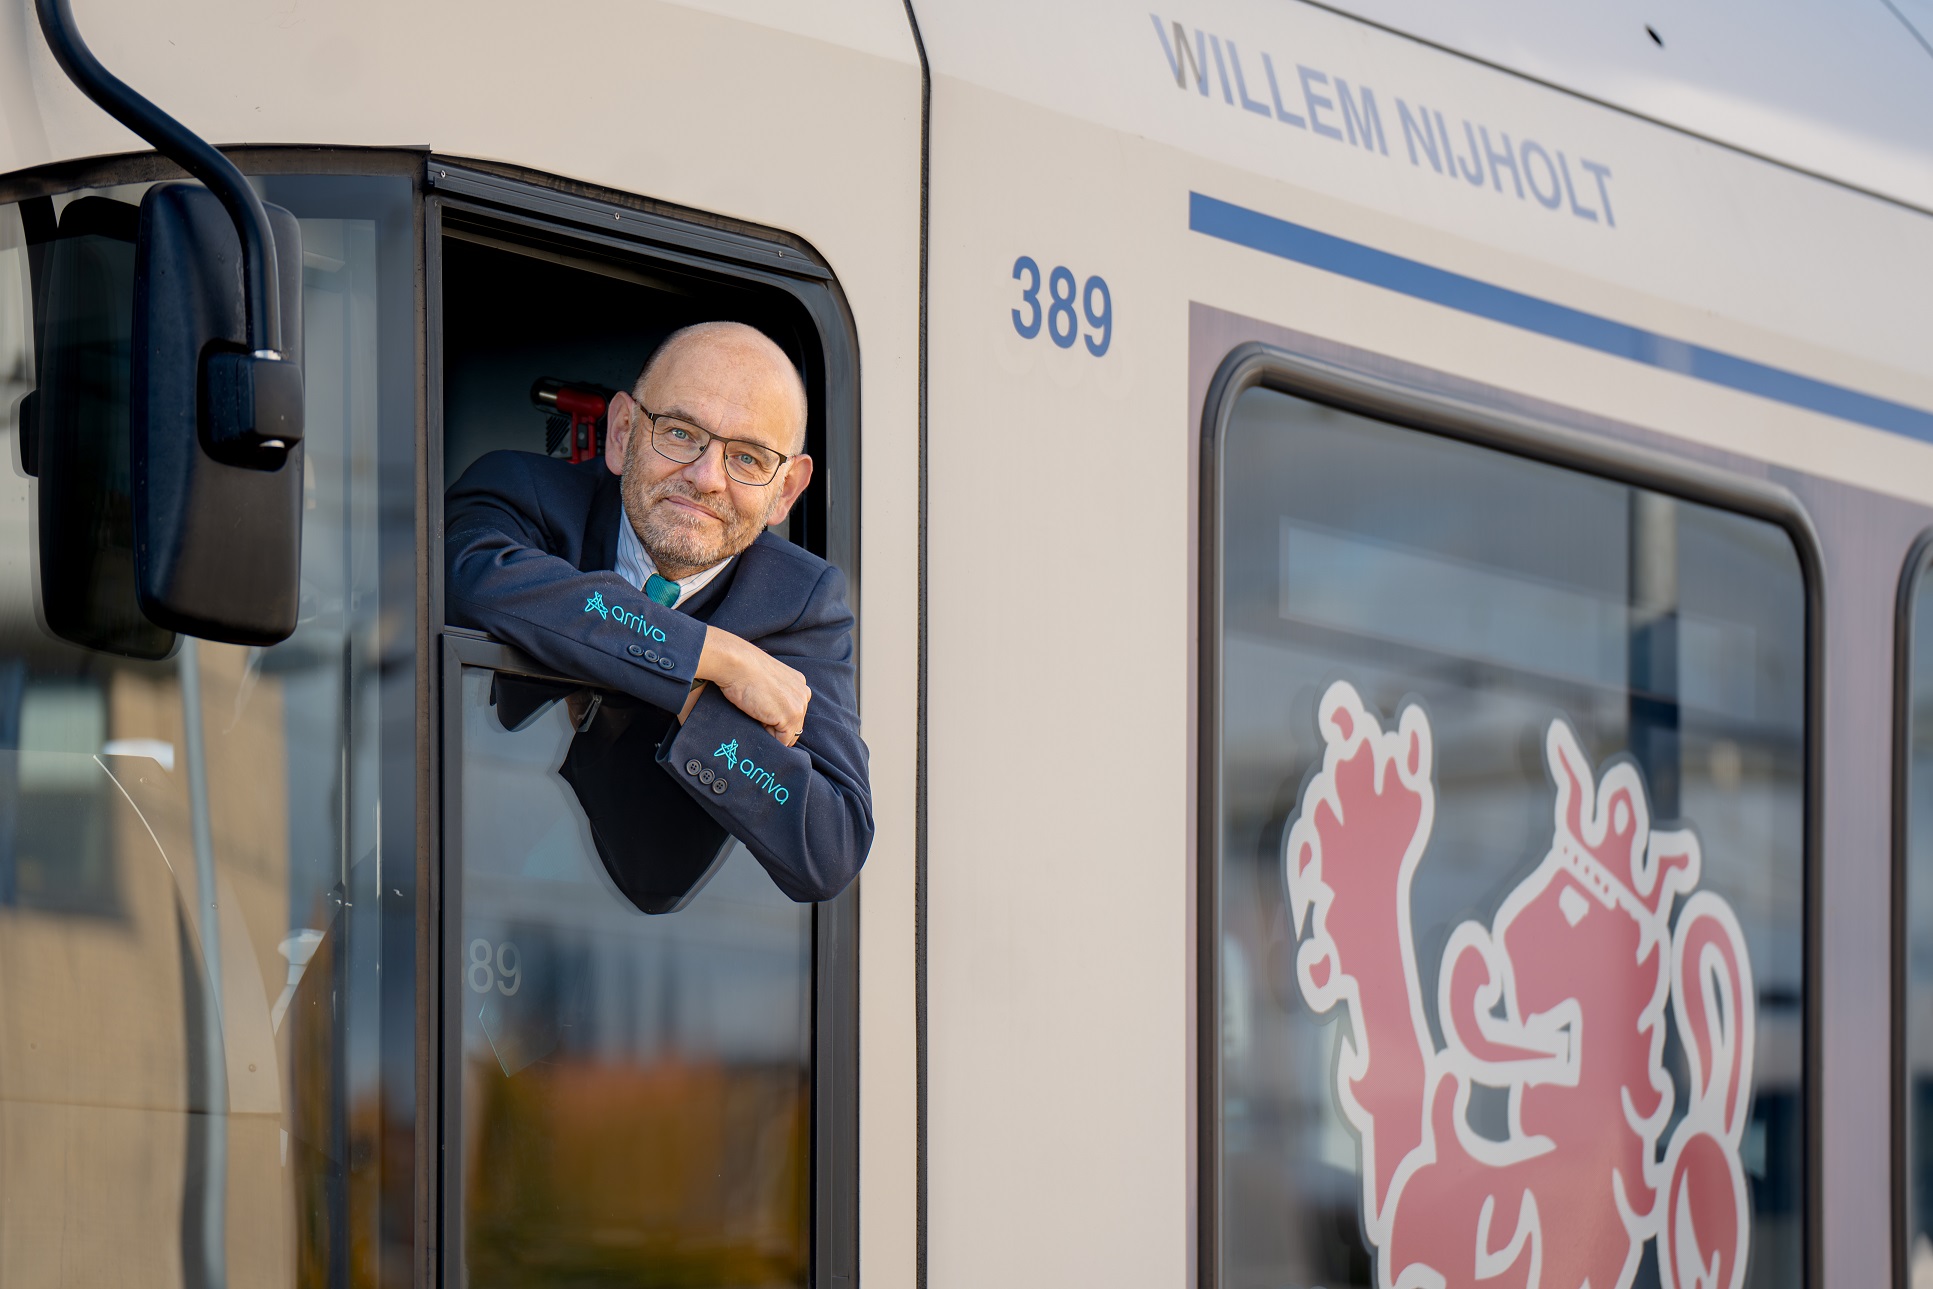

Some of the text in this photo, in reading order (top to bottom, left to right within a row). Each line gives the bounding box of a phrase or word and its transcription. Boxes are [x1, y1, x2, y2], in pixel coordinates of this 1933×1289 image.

[1149, 13, 1616, 229] WILLEM NIJHOLT
[1011, 255, 1113, 358] 389
[611, 605, 667, 643] arriva
[740, 758, 789, 805] arriva
[461, 937, 522, 997] 89
